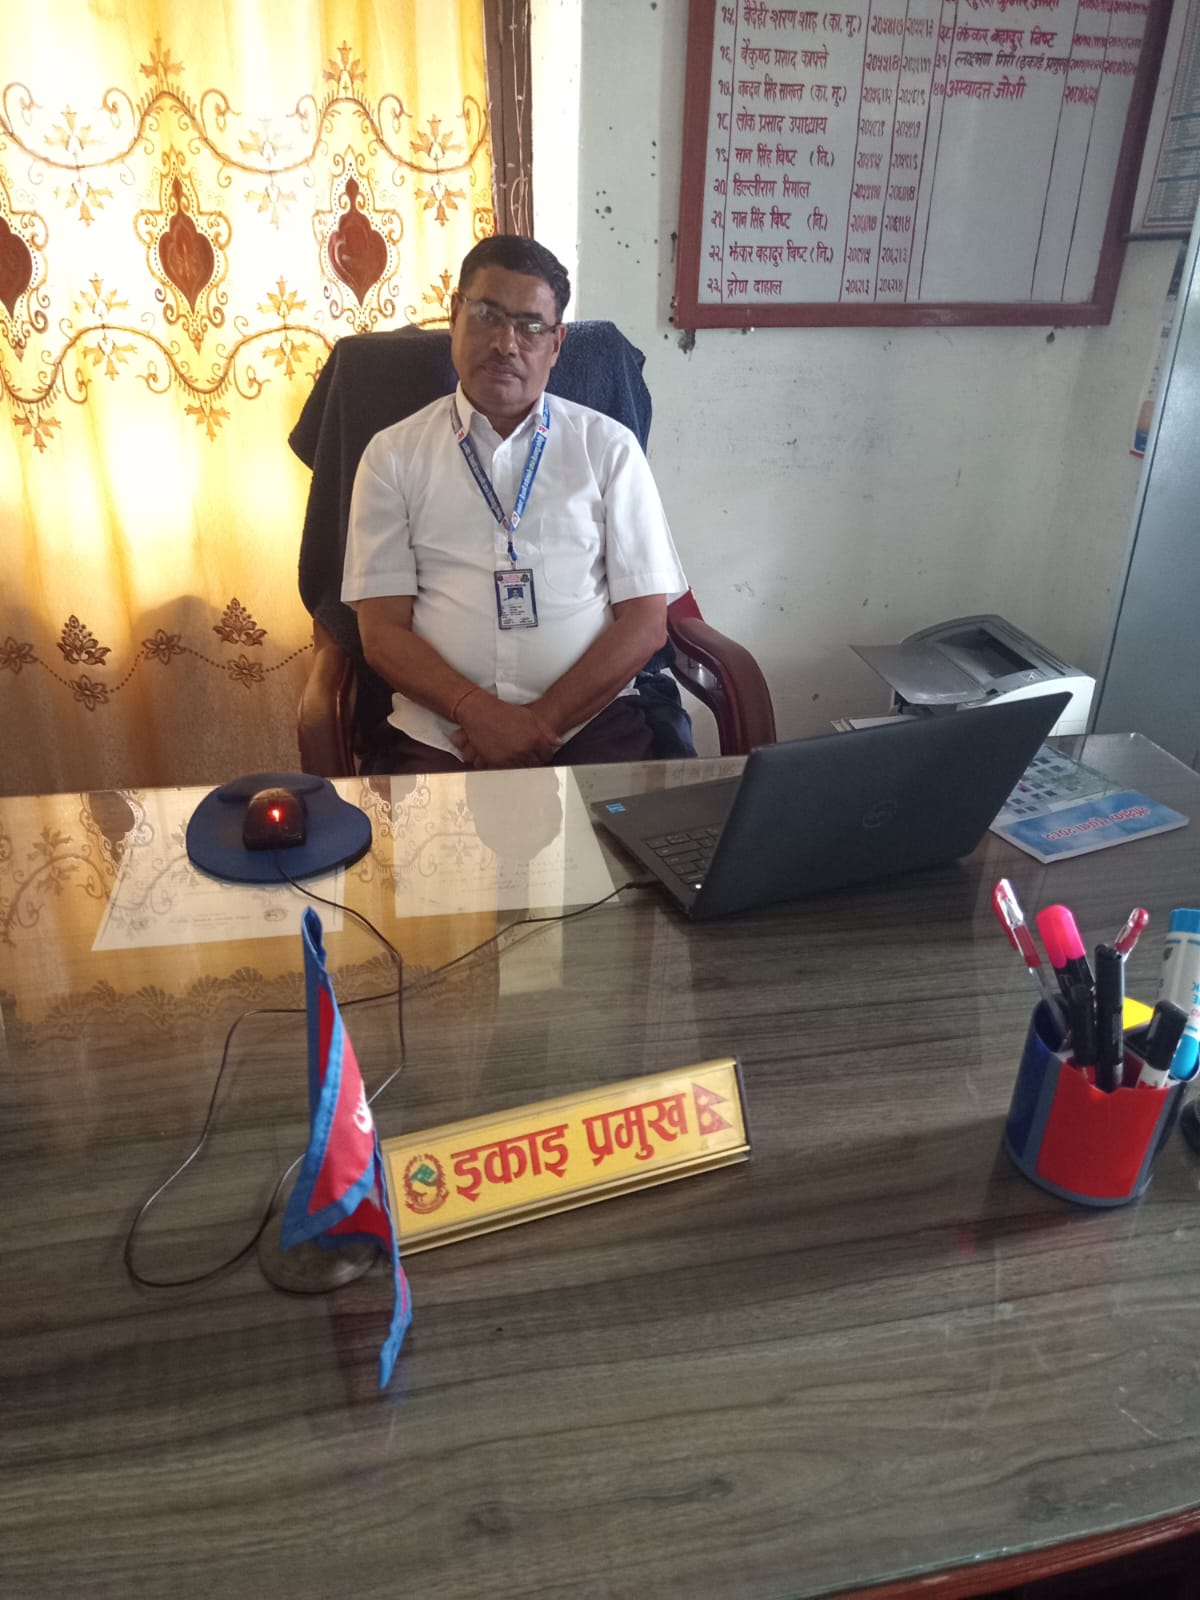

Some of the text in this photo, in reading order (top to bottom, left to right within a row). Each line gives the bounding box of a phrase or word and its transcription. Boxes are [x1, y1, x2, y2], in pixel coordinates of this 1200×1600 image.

[774, 48, 798, 70] प्रसाद
[736, 105, 756, 133] लोक
[758, 113, 786, 135] प्रसाद
[757, 143, 773, 168] सिंह
[782, 173, 811, 199] रिमाल
[750, 206, 766, 232] सिंह
[726, 272, 749, 299] द्रोण
[450, 1092, 689, 1202] इकाइ प्रमुख
